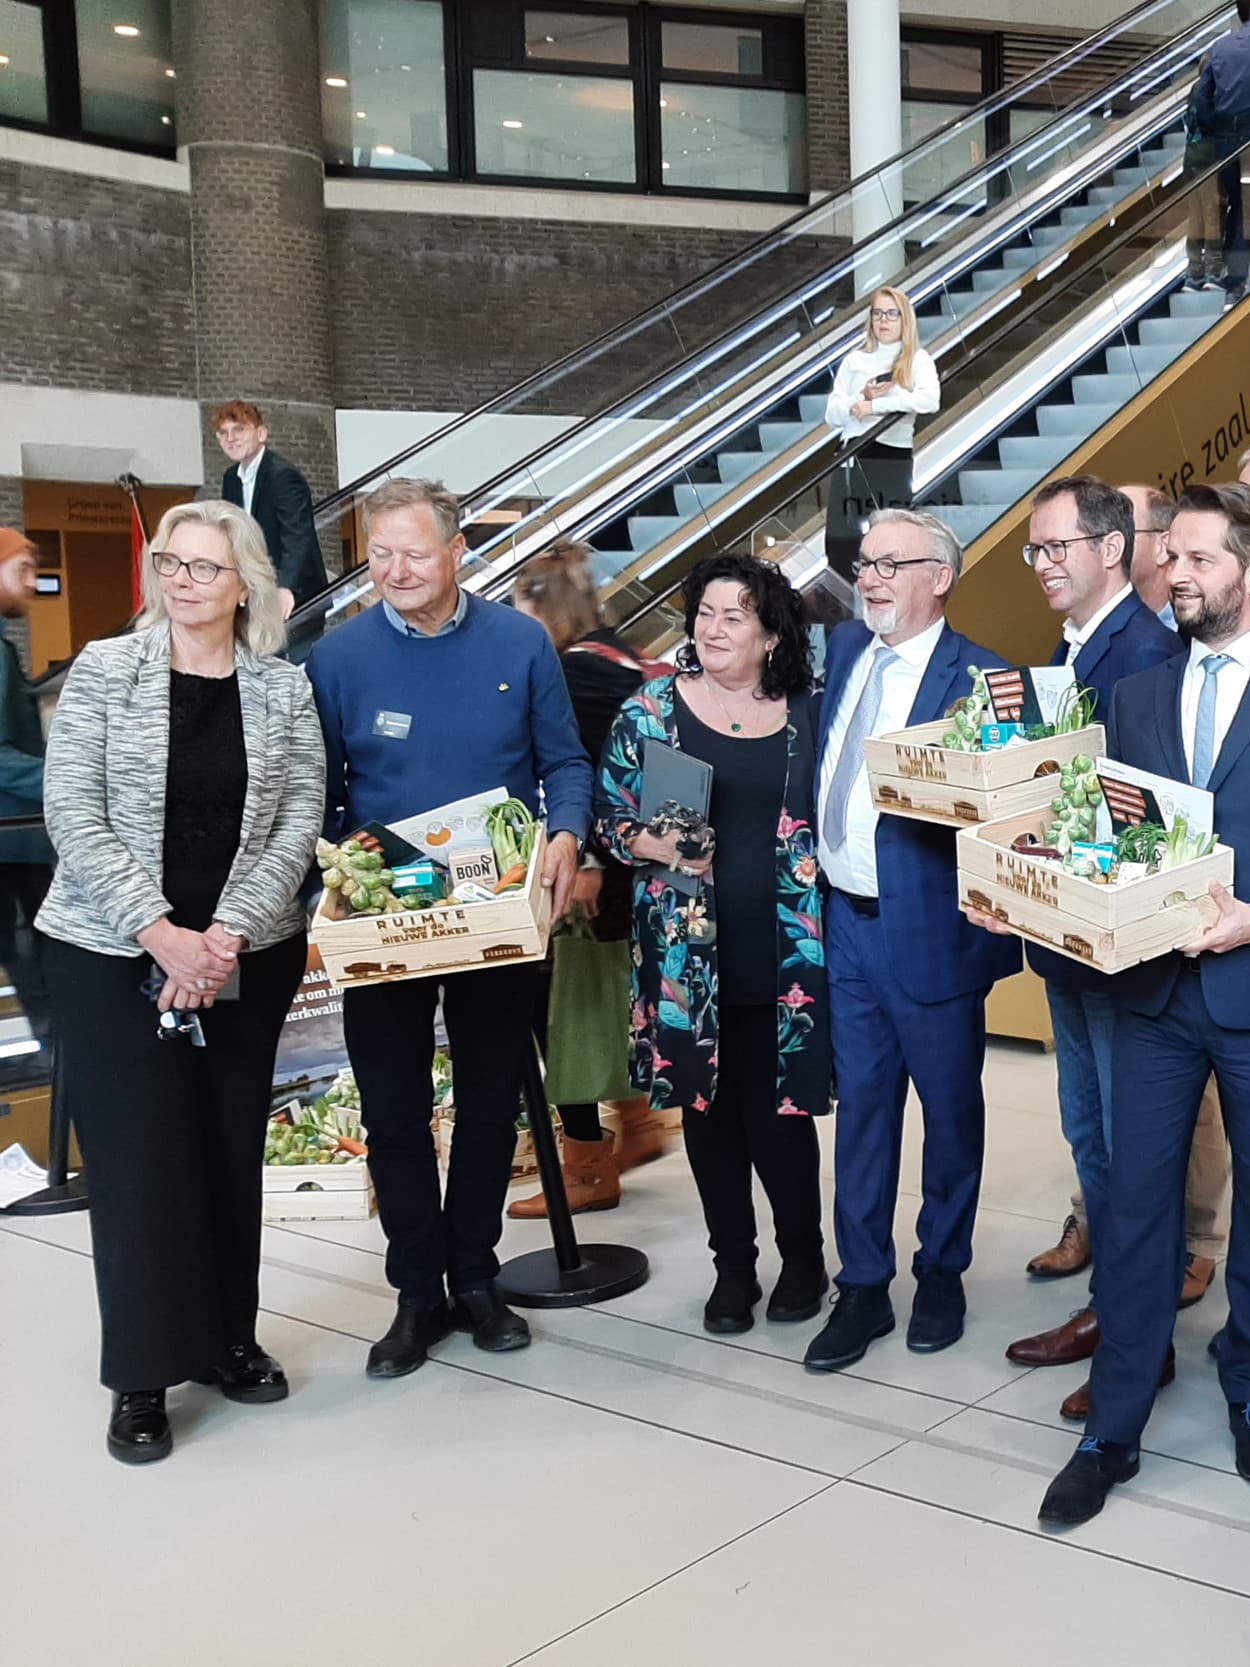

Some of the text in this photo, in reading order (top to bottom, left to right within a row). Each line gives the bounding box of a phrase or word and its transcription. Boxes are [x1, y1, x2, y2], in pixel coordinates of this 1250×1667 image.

[1201, 393, 1250, 477] zaal
[456, 862, 491, 880] BOON
[996, 852, 1058, 890] RUIMTE
[376, 909, 466, 930] RUIMTE
[382, 926, 470, 945] NIEUWE AKKER
[306, 989, 327, 1001] om
